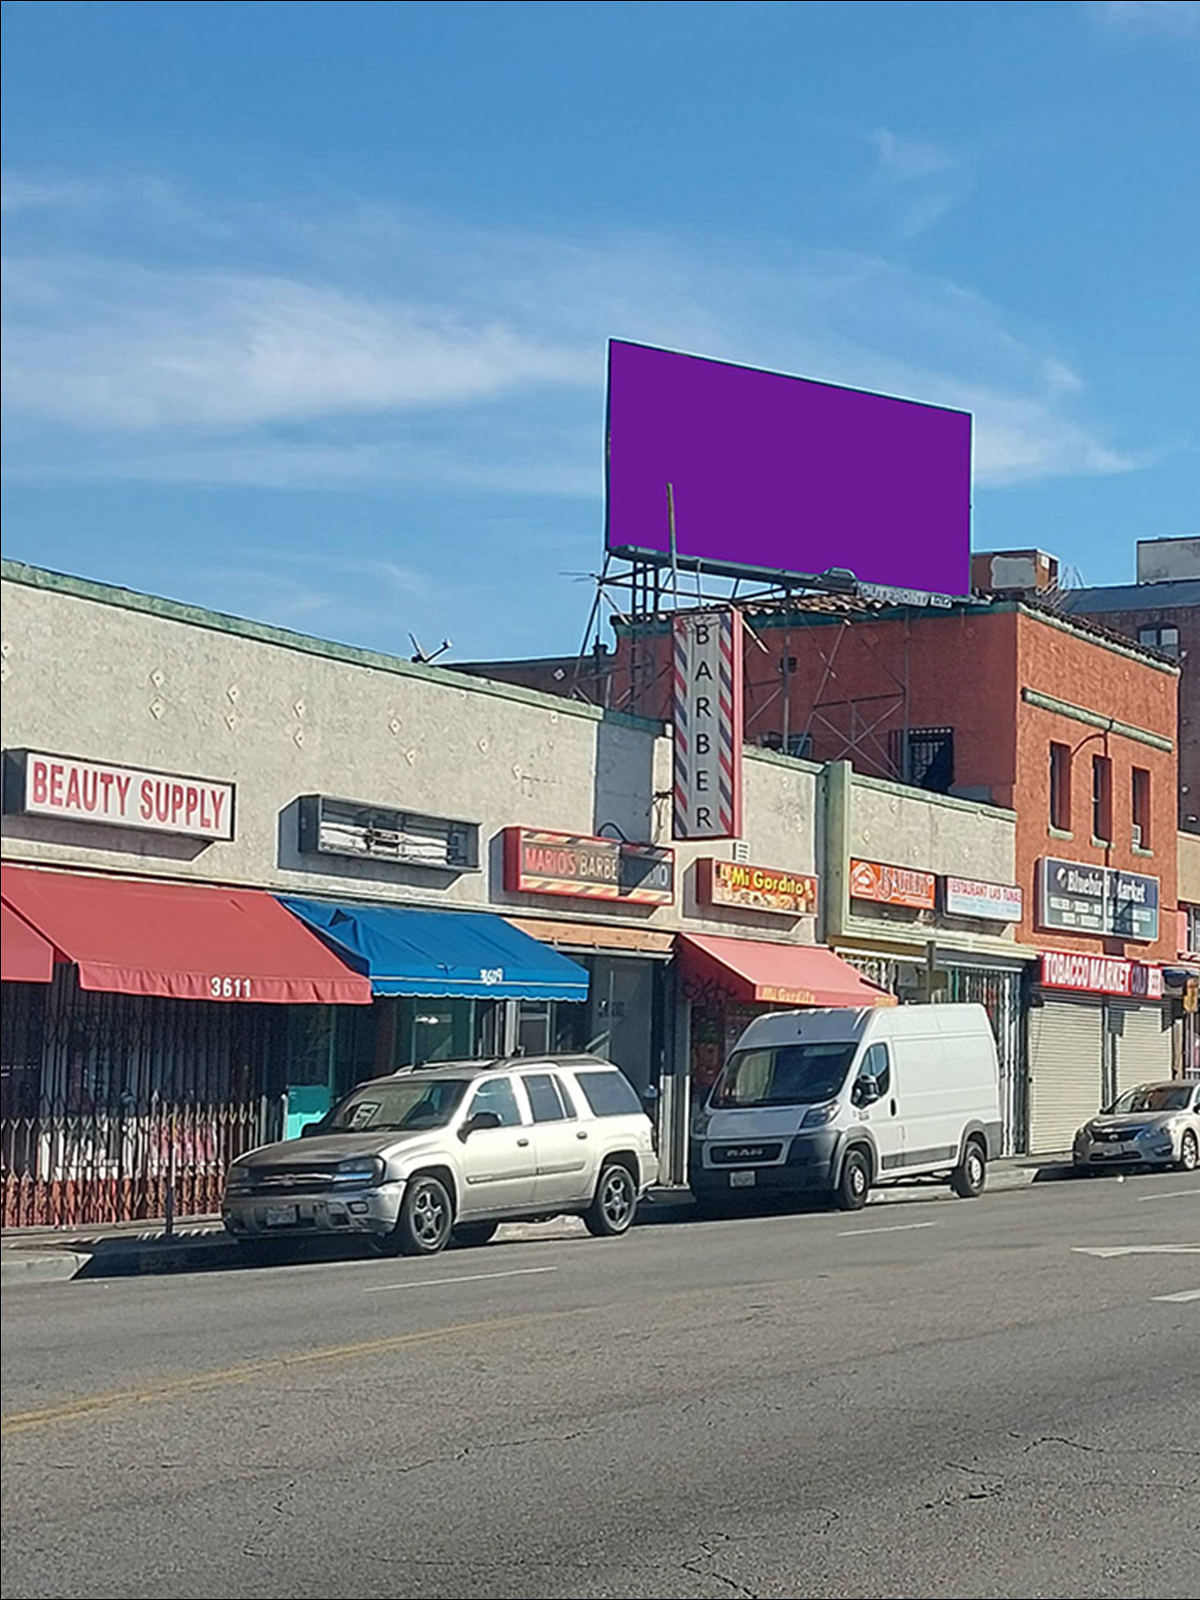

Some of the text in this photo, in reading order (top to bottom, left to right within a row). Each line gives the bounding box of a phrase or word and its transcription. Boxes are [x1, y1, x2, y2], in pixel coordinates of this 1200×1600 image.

[694, 623, 713, 829] BARBER
[33, 761, 225, 829] BEAUTY SUPPLY
[731, 866, 804, 895] Mi Gordito
[210, 976, 252, 998] 3611
[1044, 952, 1089, 986] TOBACCO
[1090, 959, 1131, 994] MARKET
